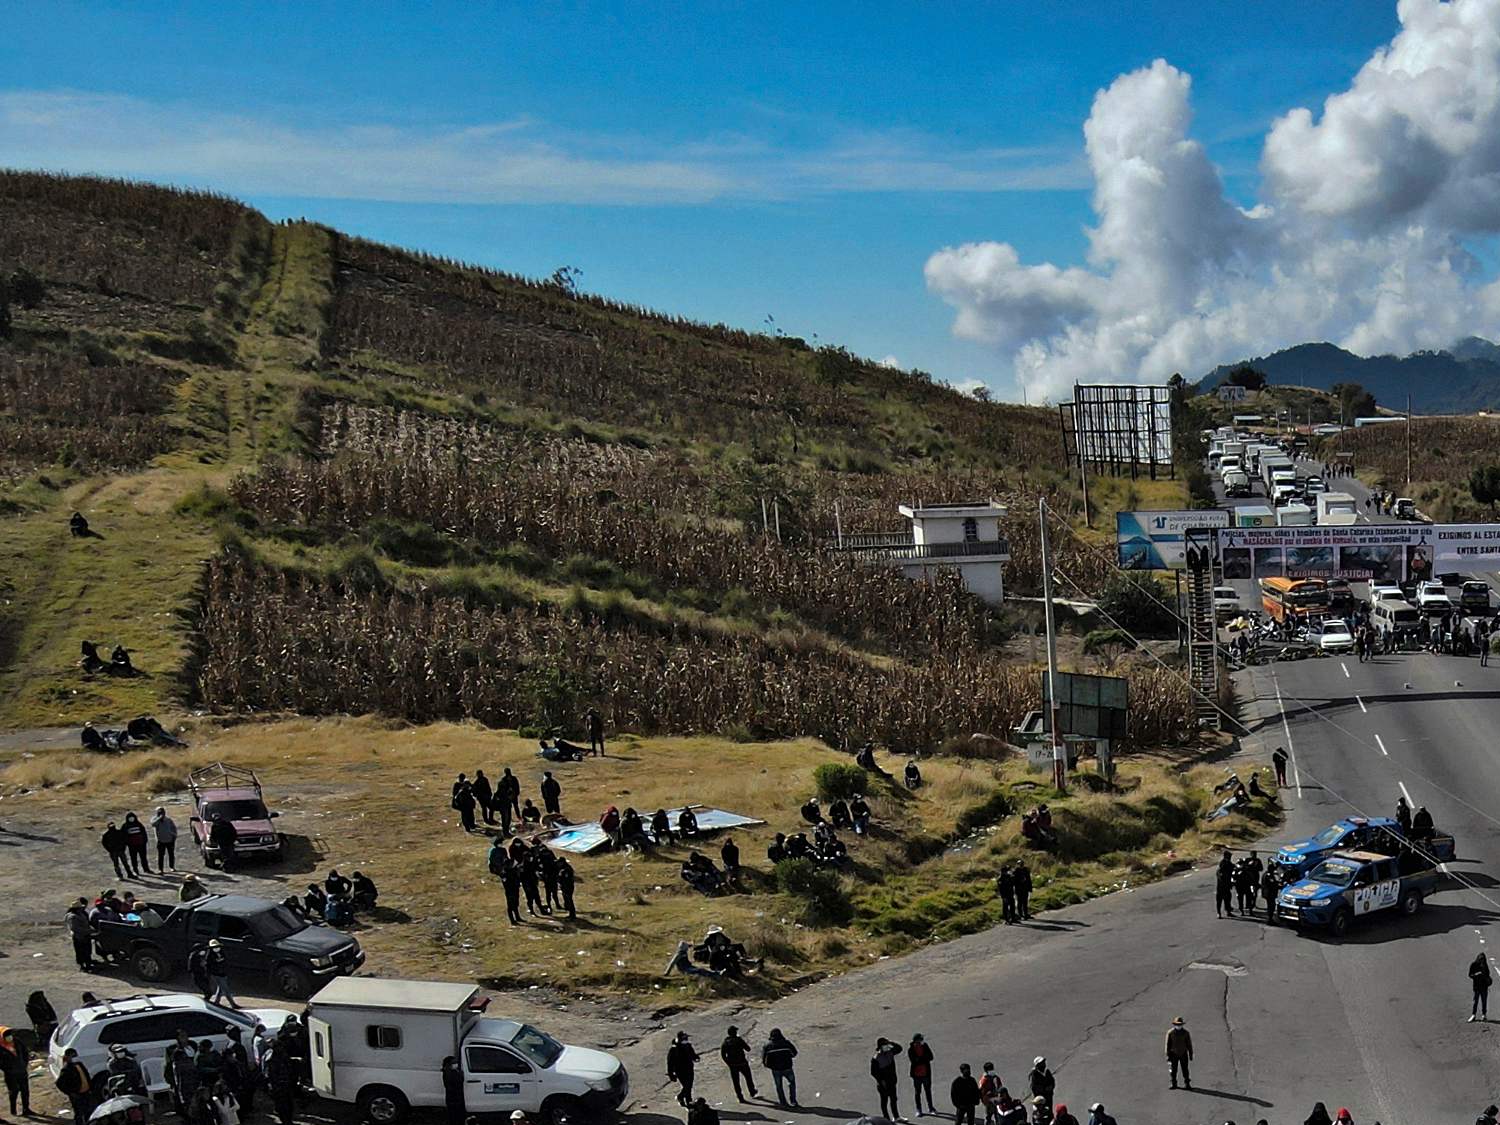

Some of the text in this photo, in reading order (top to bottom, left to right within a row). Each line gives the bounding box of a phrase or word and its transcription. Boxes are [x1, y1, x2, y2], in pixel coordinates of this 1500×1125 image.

[1332, 528, 1348, 536] Santa
[1350, 528, 1374, 536] Catarina
[1438, 531, 1472, 540] EXIGIMOS
[1474, 530, 1482, 539] AL
[1457, 546, 1478, 554] ENTRE
